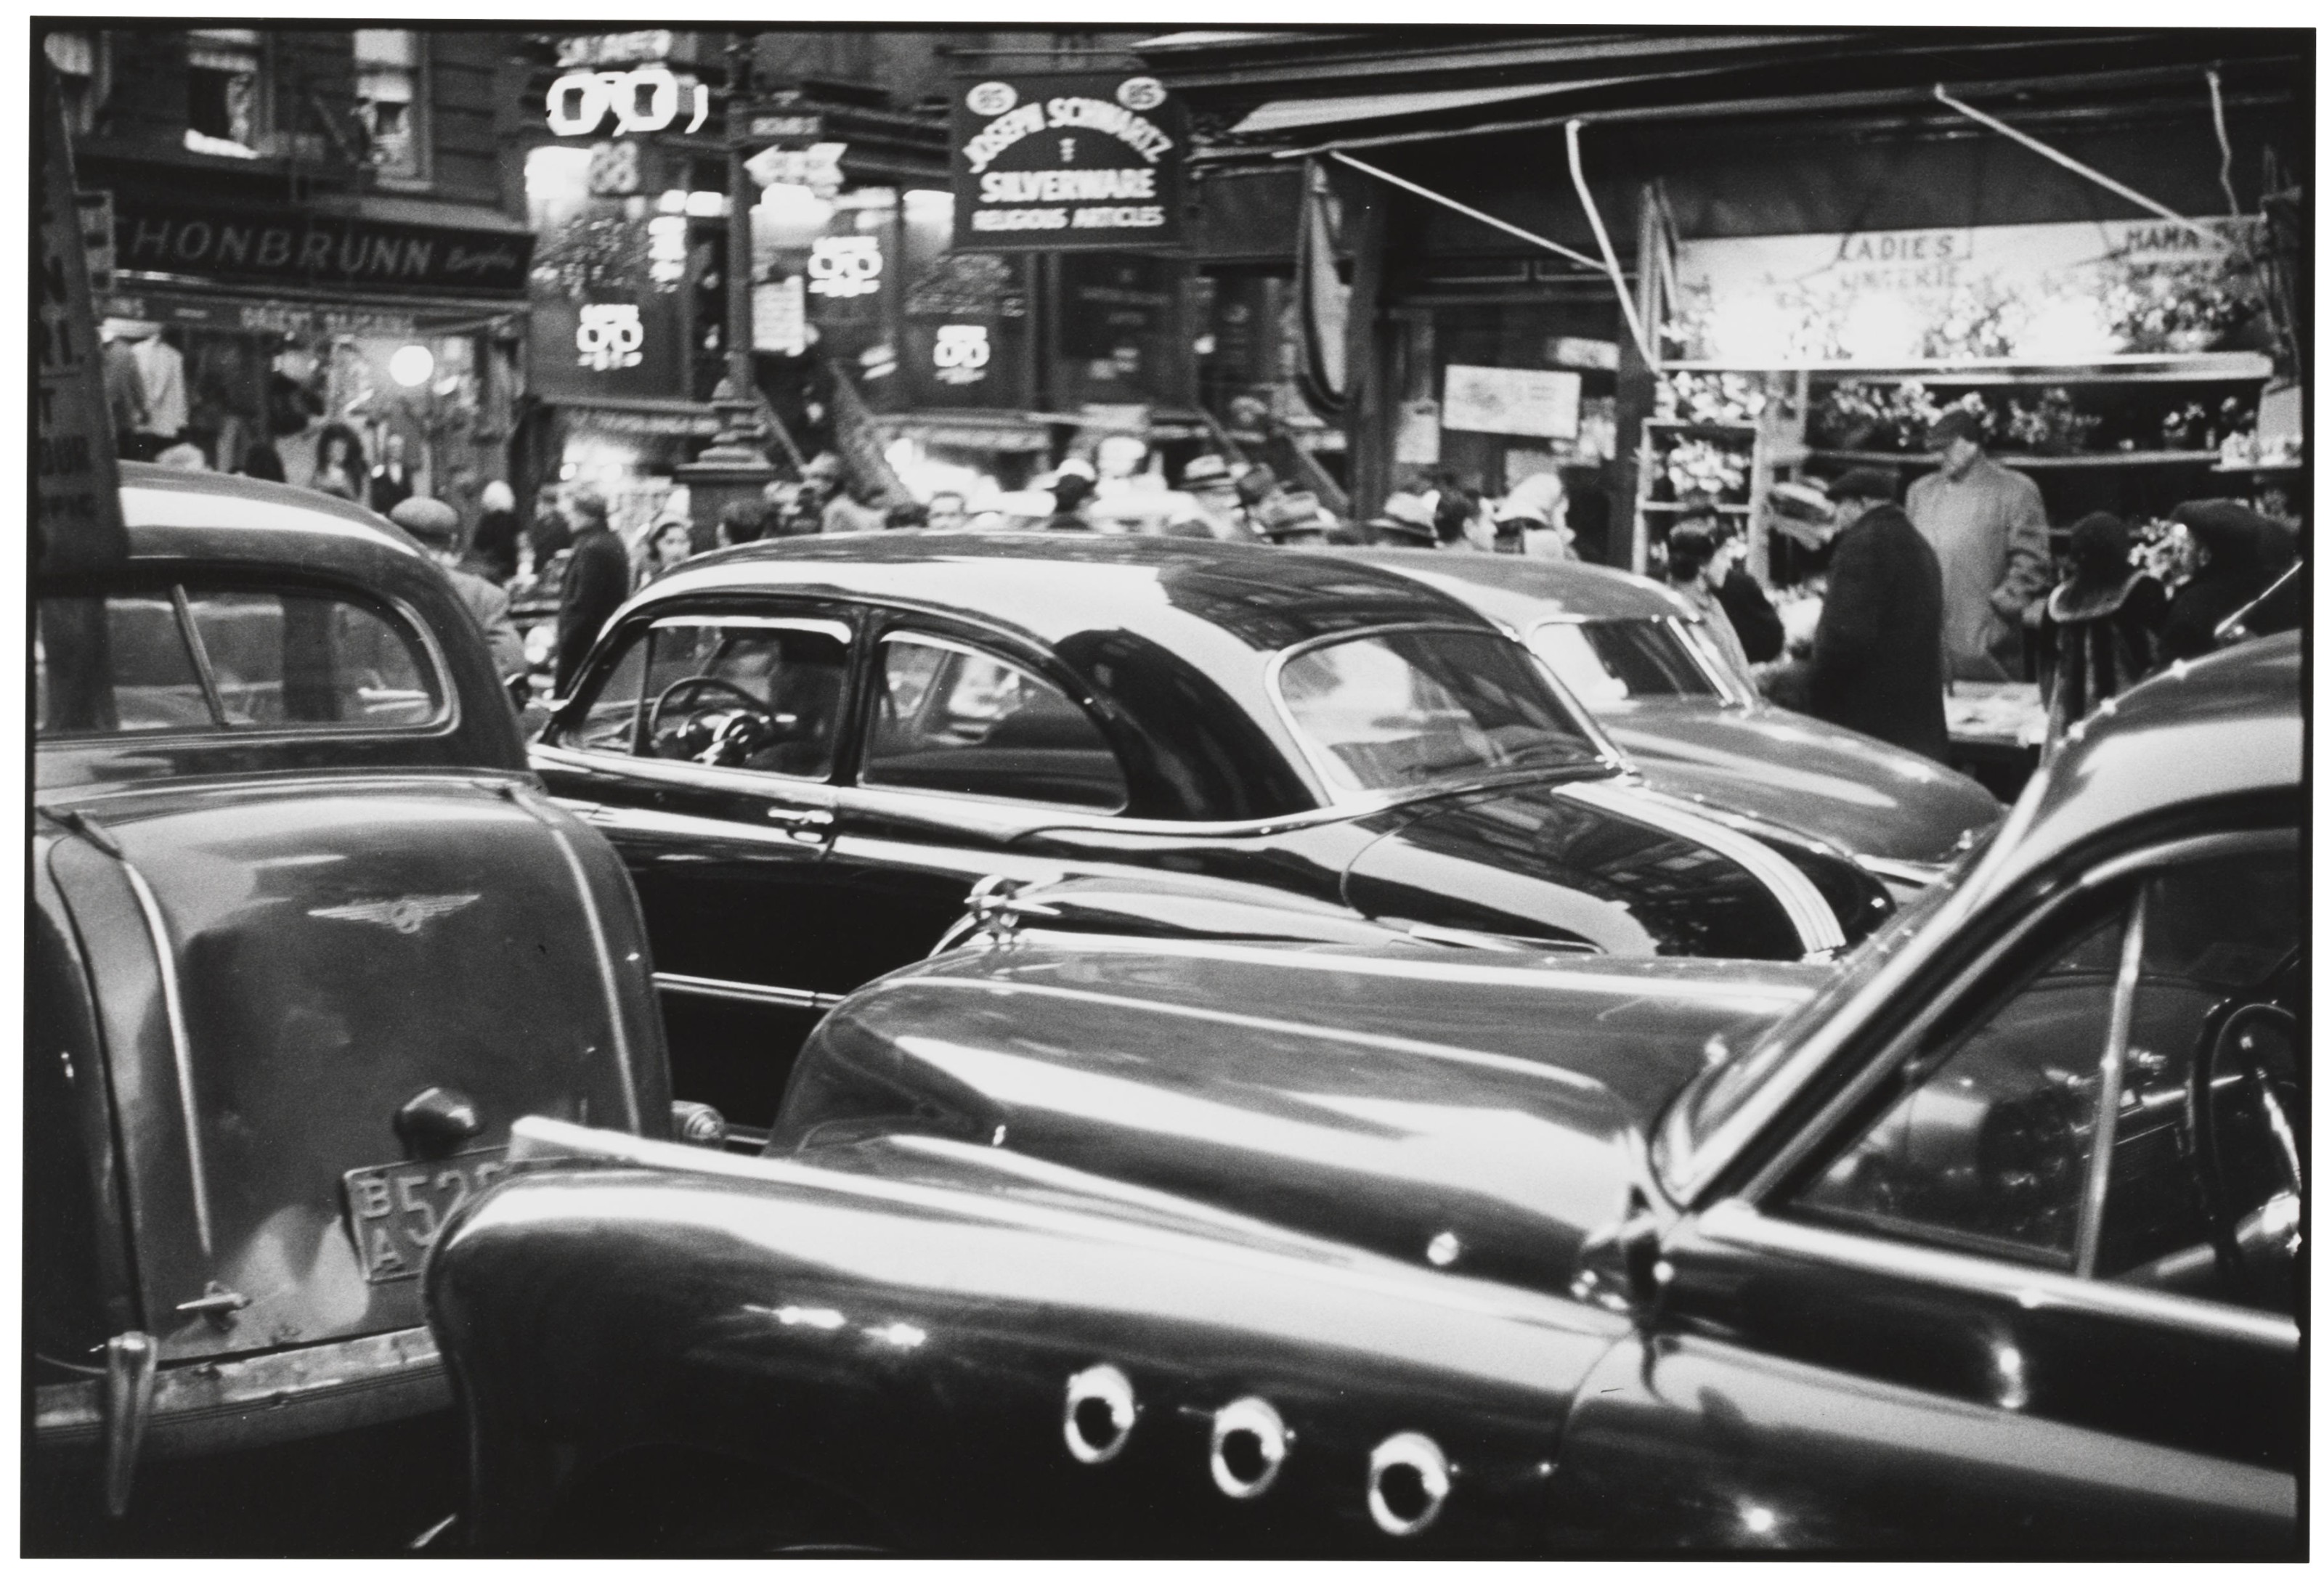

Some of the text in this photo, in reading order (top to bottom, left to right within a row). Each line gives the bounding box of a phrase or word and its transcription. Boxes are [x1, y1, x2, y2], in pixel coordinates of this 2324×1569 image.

[962, 97, 1174, 174] JOSEPH SCHWARTZ
[978, 168, 1157, 203] SILVERWARE
[971, 206, 1166, 232] RELIGIOUS ARTICLES
[116, 218, 434, 278] HONBRUNN
[1837, 235, 1954, 261] LADIES
